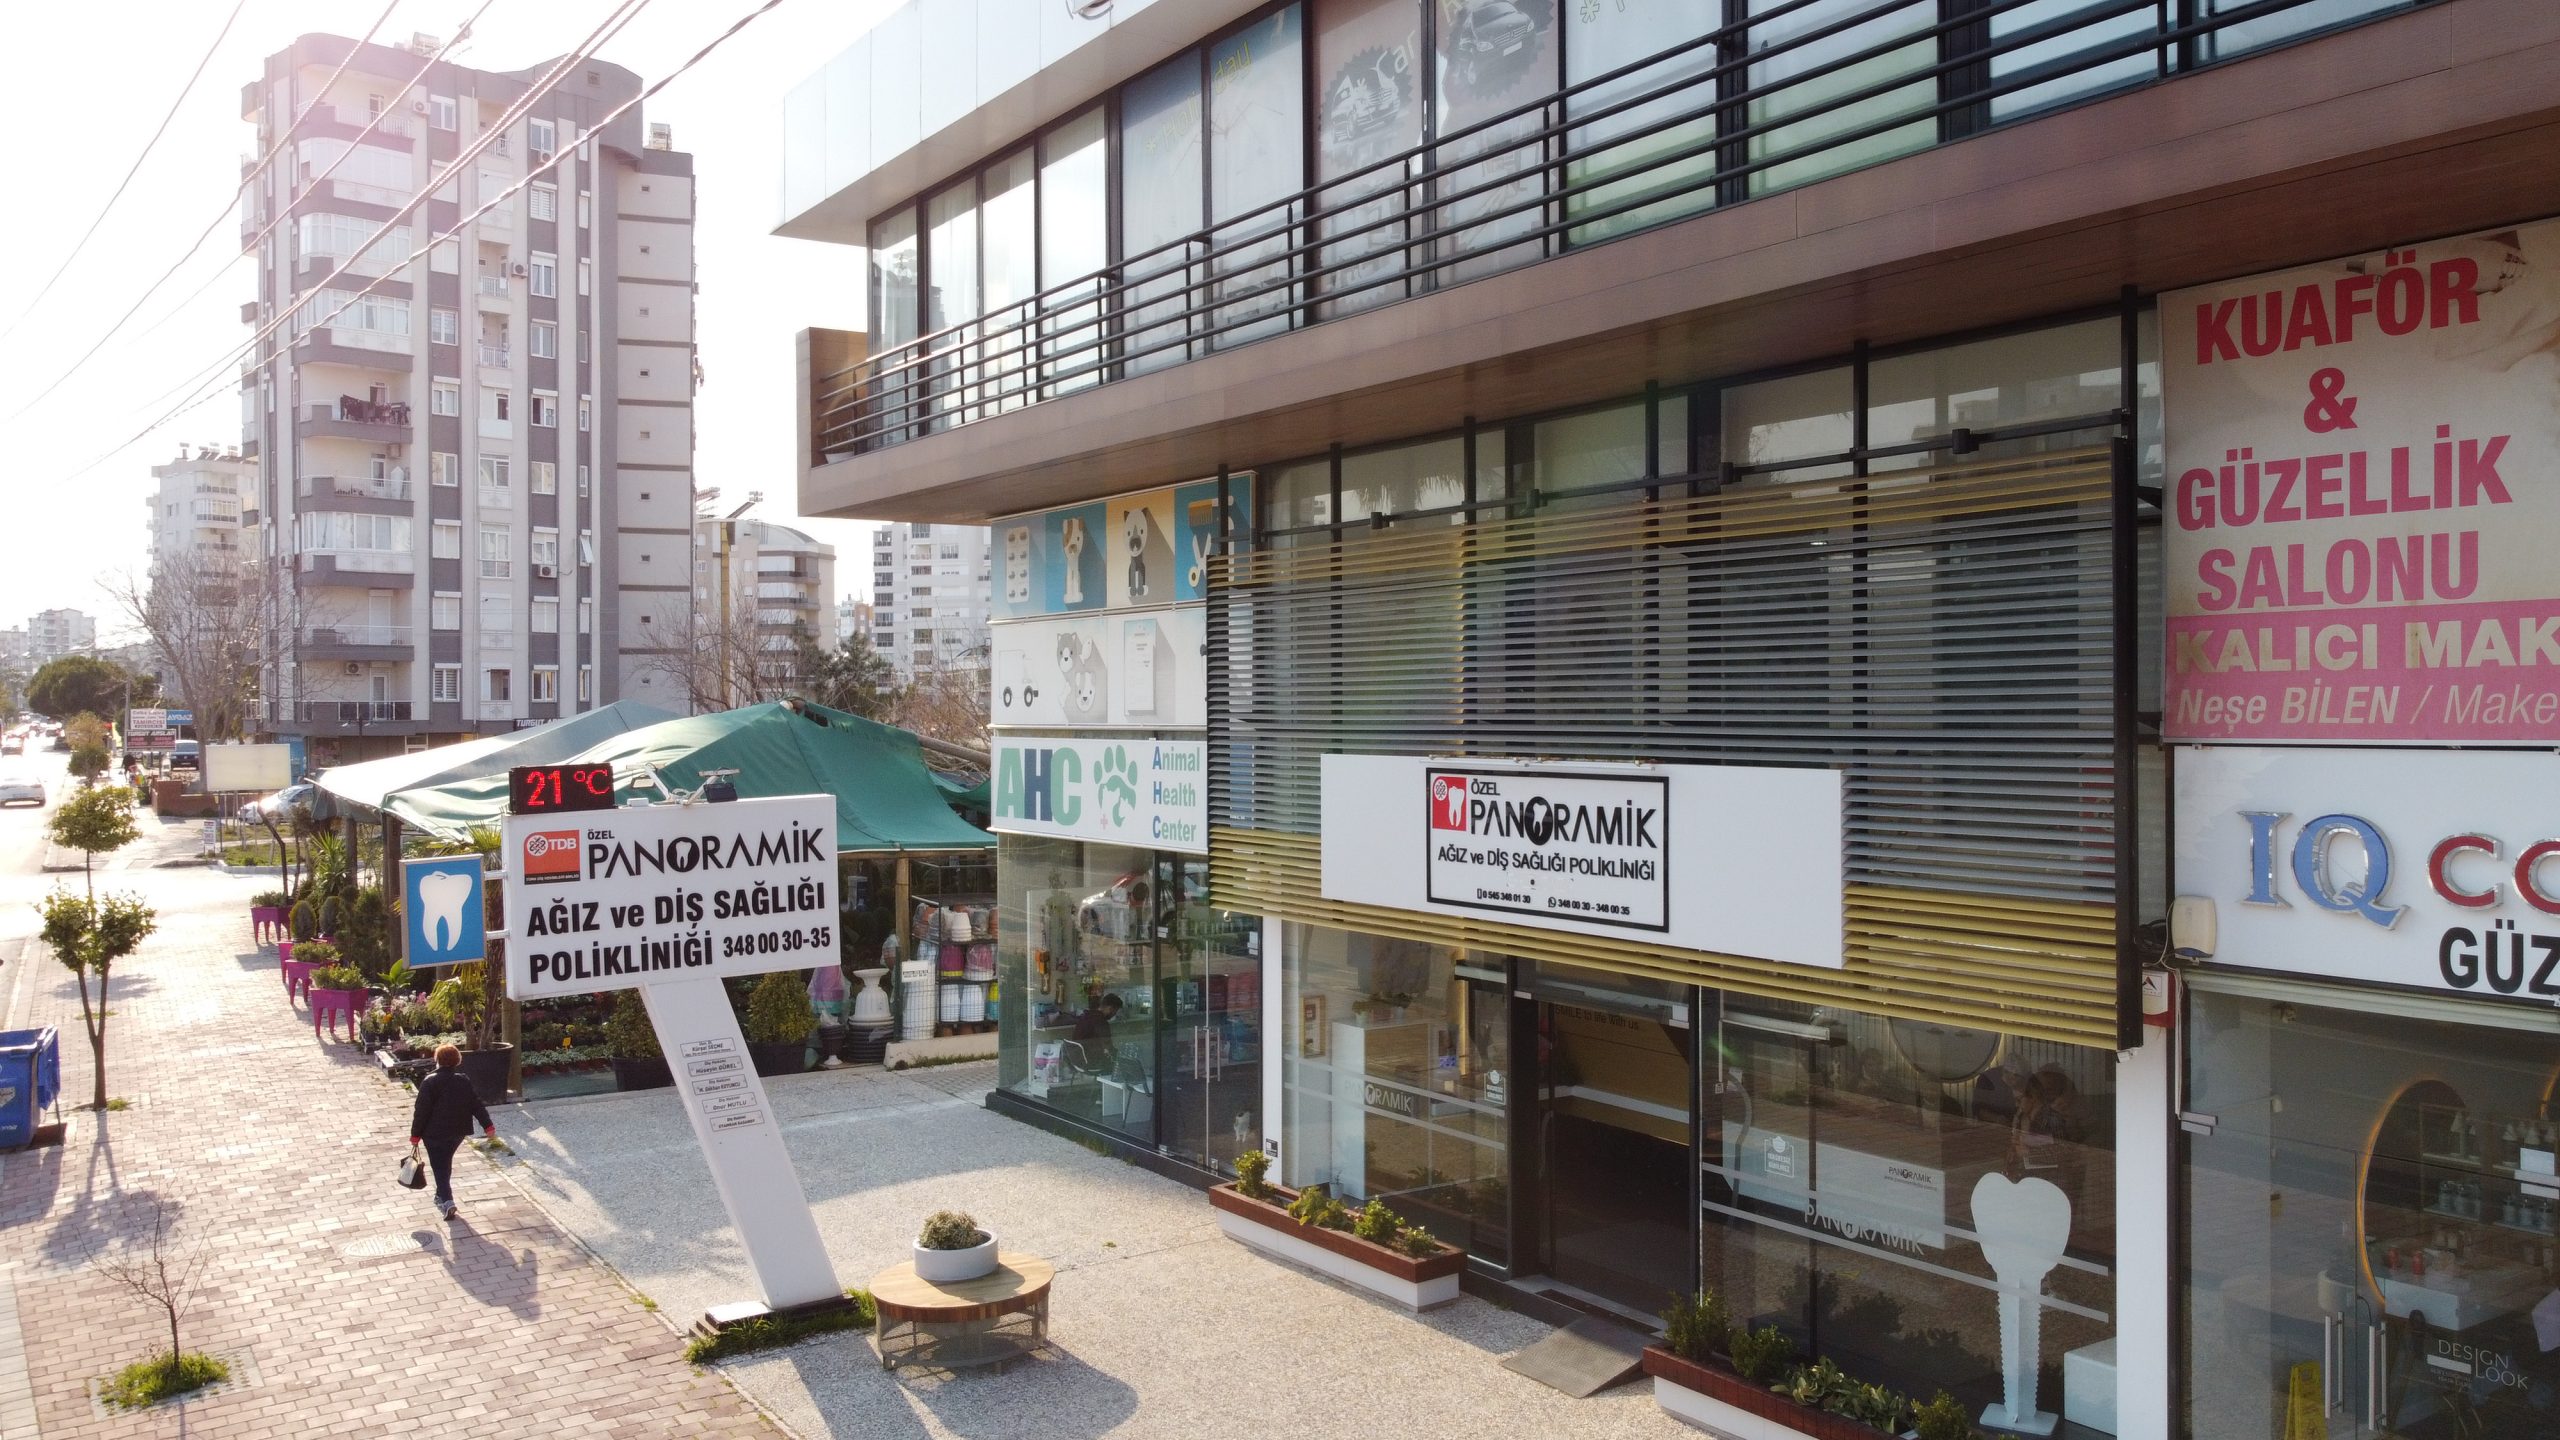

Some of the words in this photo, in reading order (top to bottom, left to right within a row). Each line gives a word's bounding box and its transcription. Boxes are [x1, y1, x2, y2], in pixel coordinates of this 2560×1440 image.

[2196, 249, 2480, 365] KUAFÖR
[2303, 367, 2358, 433] &
[2176, 424, 2513, 531] GÜZELLİK
[2197, 531, 2479, 611] SALONU
[2175, 623, 2378, 674] KALICI
[2405, 616, 2560, 670] MAK
[2176, 688, 2267, 733] Neşe
[2280, 678, 2399, 725] BİLEN
[1152, 746, 1200, 772] Animal
[526, 770, 563, 806] 21
[996, 747, 1082, 826] AHC
[1153, 781, 1196, 807] Health
[1471, 779, 1500, 796] ÖZEL
[588, 829, 615, 841] ÖZEL
[1152, 815, 1197, 842] Center
[1471, 796, 1657, 849] PANORAMİK
[548, 838, 576, 850] TDB
[588, 820, 826, 880] PANORAMİK
[1438, 844, 1467, 864] AĞIZ
[1470, 851, 1484, 865] ve
[1487, 848, 1509, 870] DİŞ
[1512, 851, 1565, 873] SAĞLIĞI
[1569, 856, 1655, 881] POLİKLİNİĞİ
[2237, 810, 2411, 930] IQ
[527, 898, 600, 937] AĞIZ
[610, 904, 644, 929] ve
[655, 887, 704, 929] DİŞ
[714, 876, 825, 920] SAĞLIĞI
[1522, 895, 1531, 904] 30
[1558, 899, 1571, 908] 348
[1572, 900, 1581, 910] 00
[1581, 902, 1591, 911] 30
[1610, 904, 1619, 914] 00
[1620, 906, 1630, 915] 35
[530, 929, 713, 984] POLİKLİNİĞİ
[723, 935, 755, 958] 348
[758, 932, 779, 954] 00
[782, 926, 831, 951] 30-35
[1888, 1166, 1932, 1183] PANORAMİK
[2438, 1340, 2509, 1370] DESIGN
[2475, 1362, 2528, 1390] LOOK
